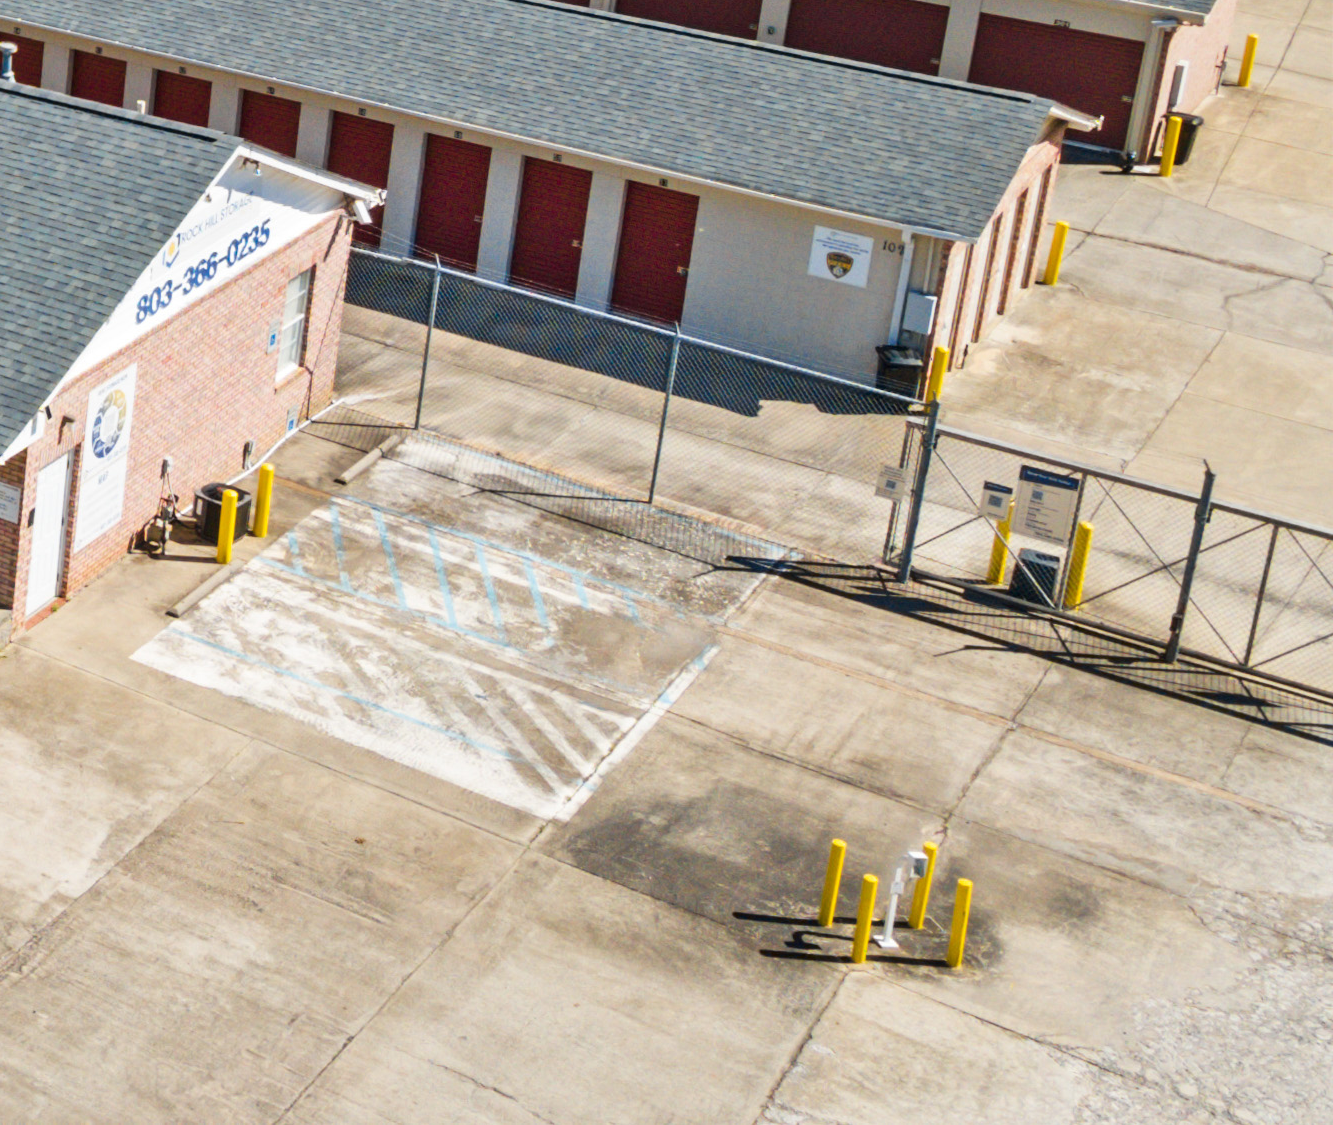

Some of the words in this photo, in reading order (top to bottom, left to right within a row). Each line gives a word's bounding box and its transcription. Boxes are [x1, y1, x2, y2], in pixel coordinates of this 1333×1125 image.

[180, 221, 203, 243] ROCK
[205, 212, 218, 230] HILL
[135, 218, 271, 325] 803-366-0235
